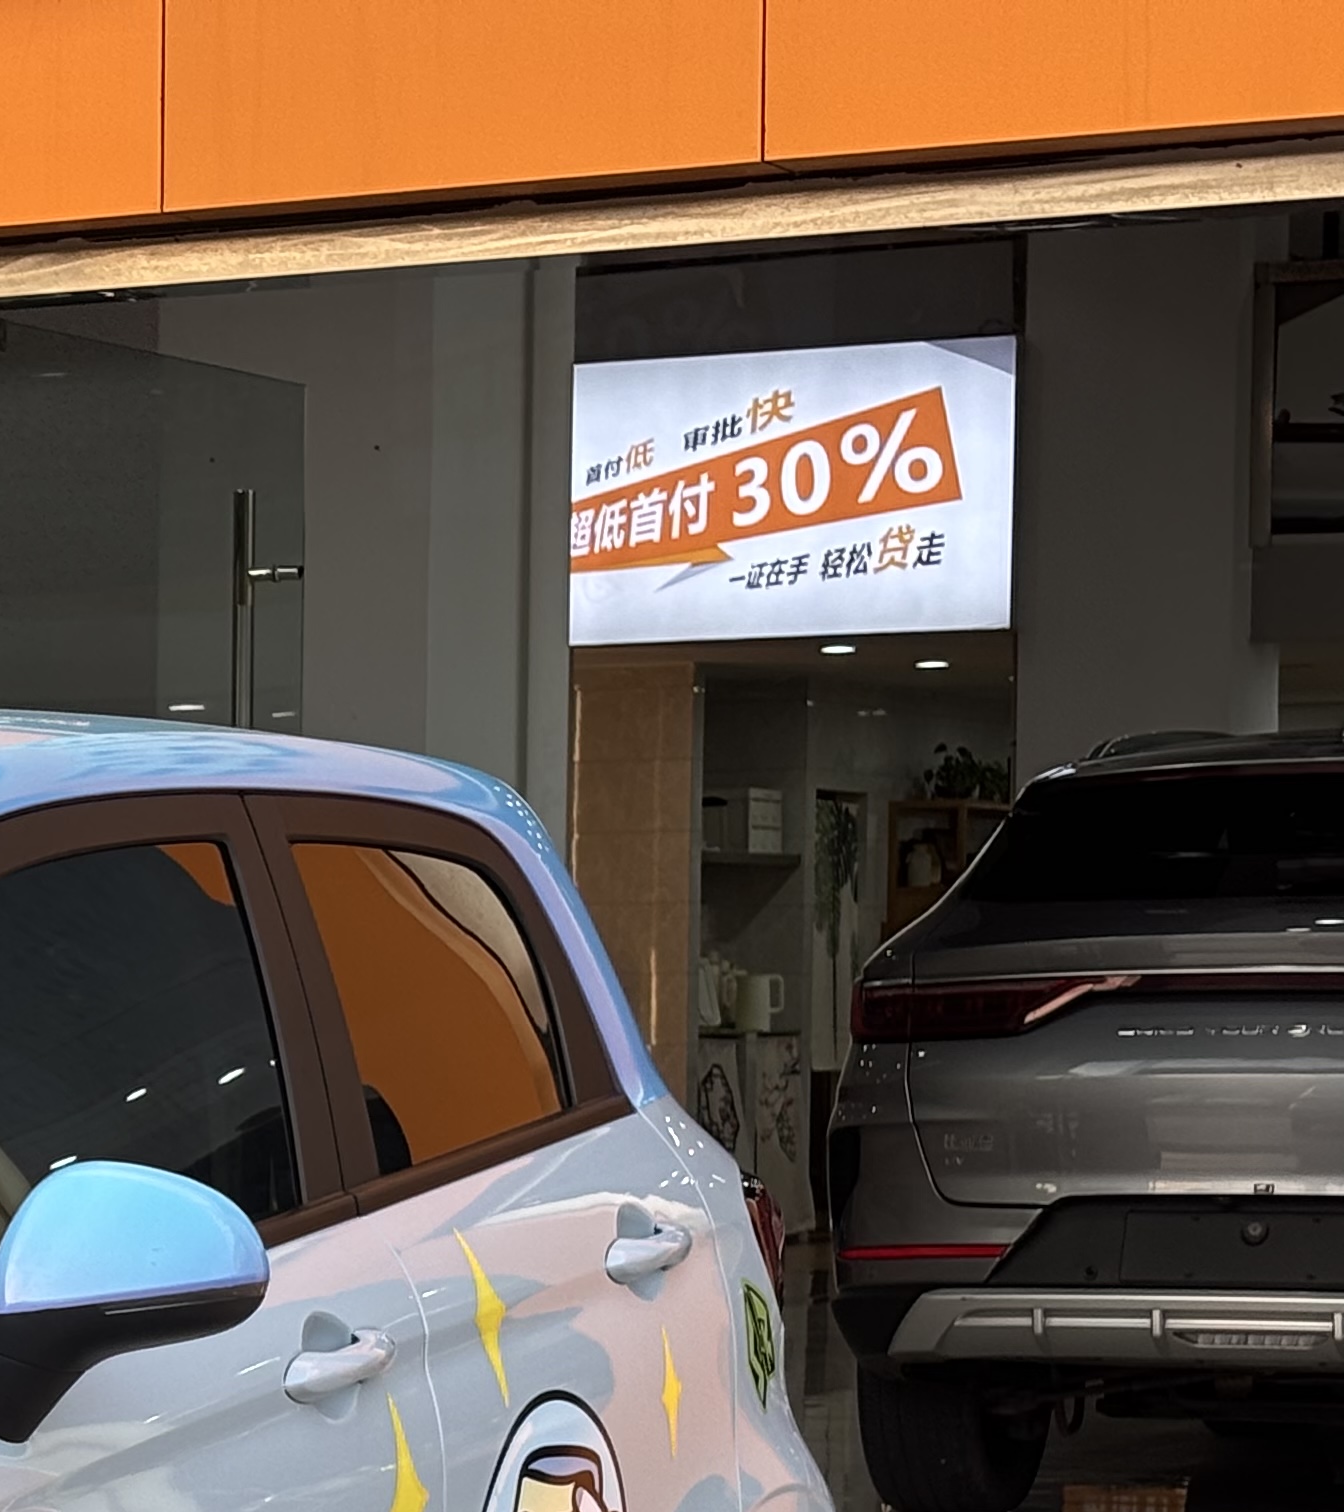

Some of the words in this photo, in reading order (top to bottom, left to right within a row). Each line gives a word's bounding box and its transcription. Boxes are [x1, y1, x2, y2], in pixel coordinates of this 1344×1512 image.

[571, 472, 715, 558] 超低首付
[733, 408, 944, 528] 30%
[586, 437, 655, 486] 首付低
[683, 389, 795, 452] 审批快
[729, 554, 810, 589] 一证在手
[819, 524, 945, 581] 轻松贷走
